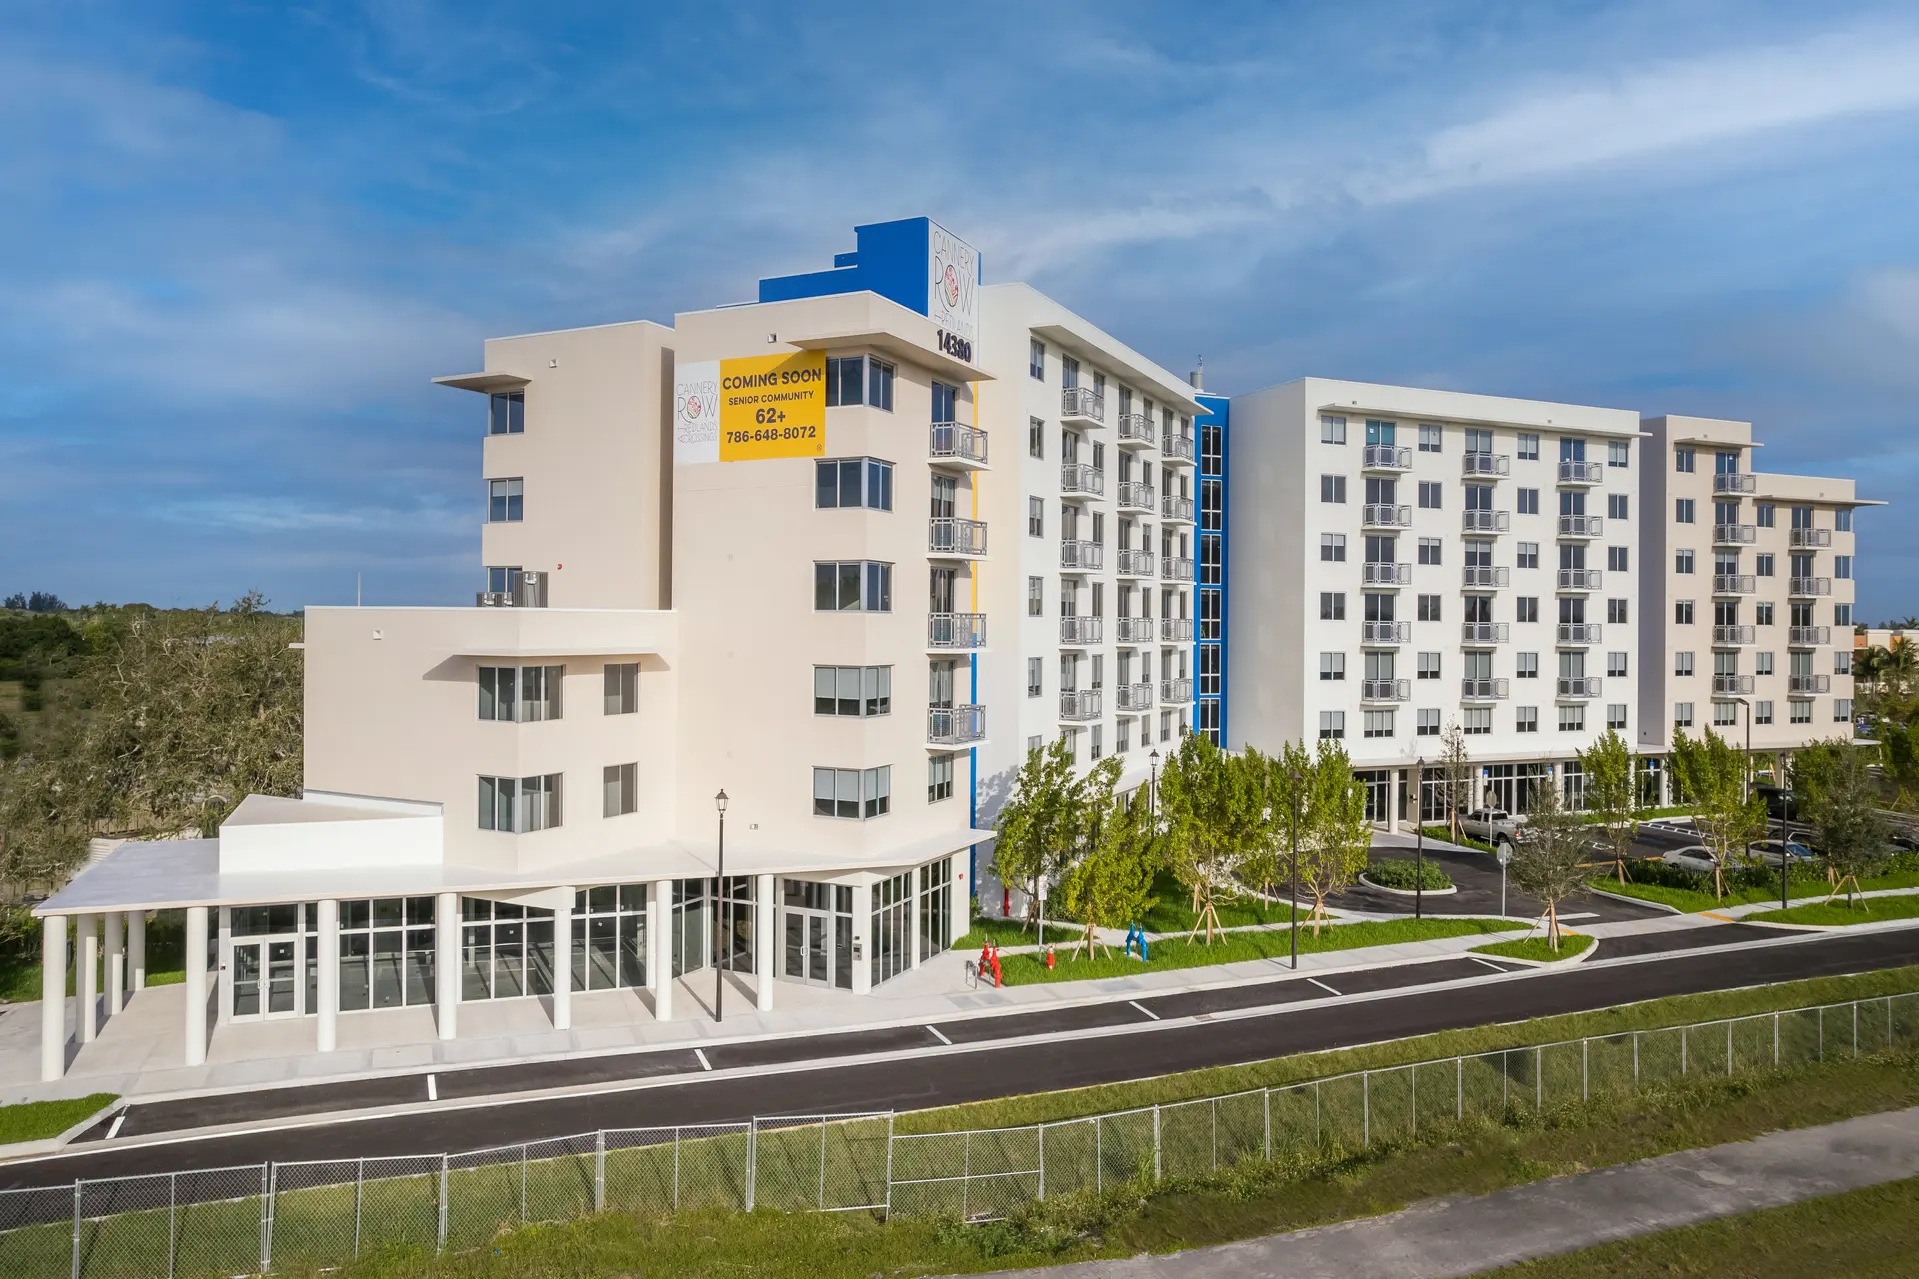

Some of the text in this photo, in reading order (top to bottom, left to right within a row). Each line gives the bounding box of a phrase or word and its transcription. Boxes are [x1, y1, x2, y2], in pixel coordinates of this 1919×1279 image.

[934, 231, 974, 276] CANNERY
[934, 255, 974, 316] ROW
[937, 330, 972, 362] 14380
[676, 381, 718, 396] CANNERY
[722, 368, 821, 390] COMING SOON
[728, 390, 814, 406] SENIOR COMMUNITY
[677, 395, 718, 424] ROW
[755, 407, 786, 424] 62+
[727, 425, 816, 443] 786-648-8072
